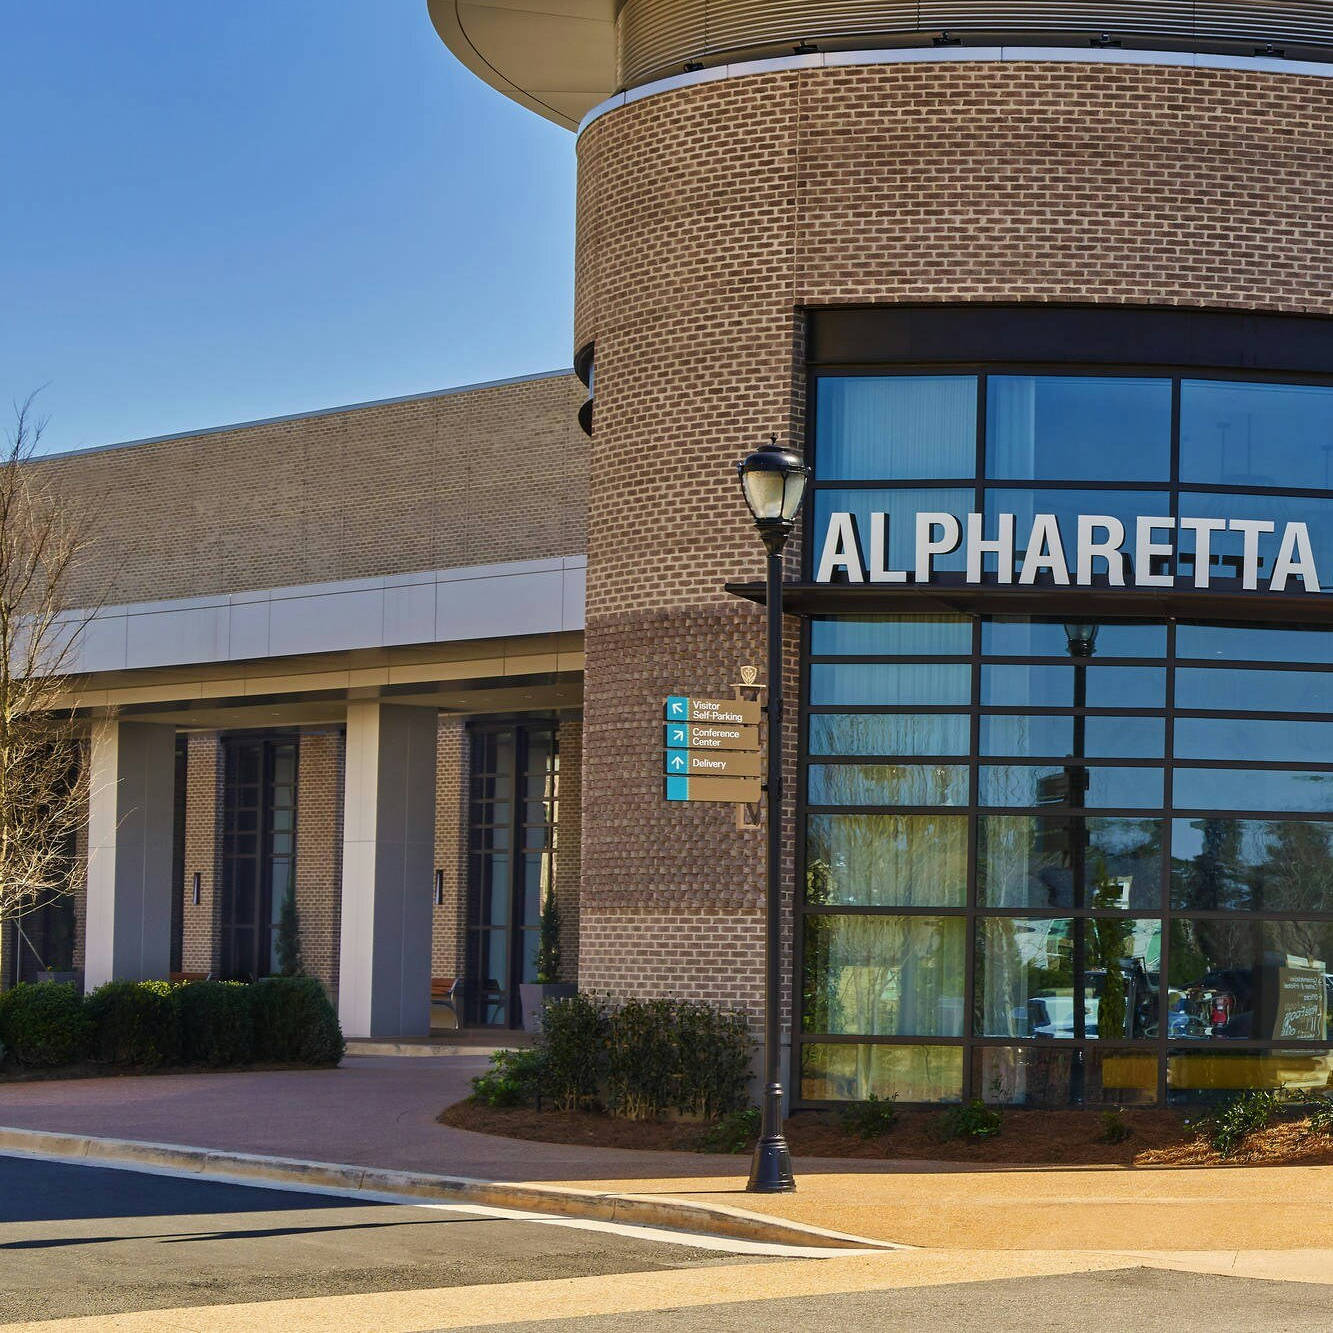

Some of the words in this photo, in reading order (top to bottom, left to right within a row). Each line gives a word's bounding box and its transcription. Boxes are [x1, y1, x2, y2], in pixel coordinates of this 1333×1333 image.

[815, 512, 1321, 592] ALPHARETTA
[693, 701, 720, 710] Visitor
[693, 711, 743, 722] Self-Parking
[692, 728, 740, 738] Conference
[692, 737, 721, 746] Center
[692, 759, 726, 769] Delivery
